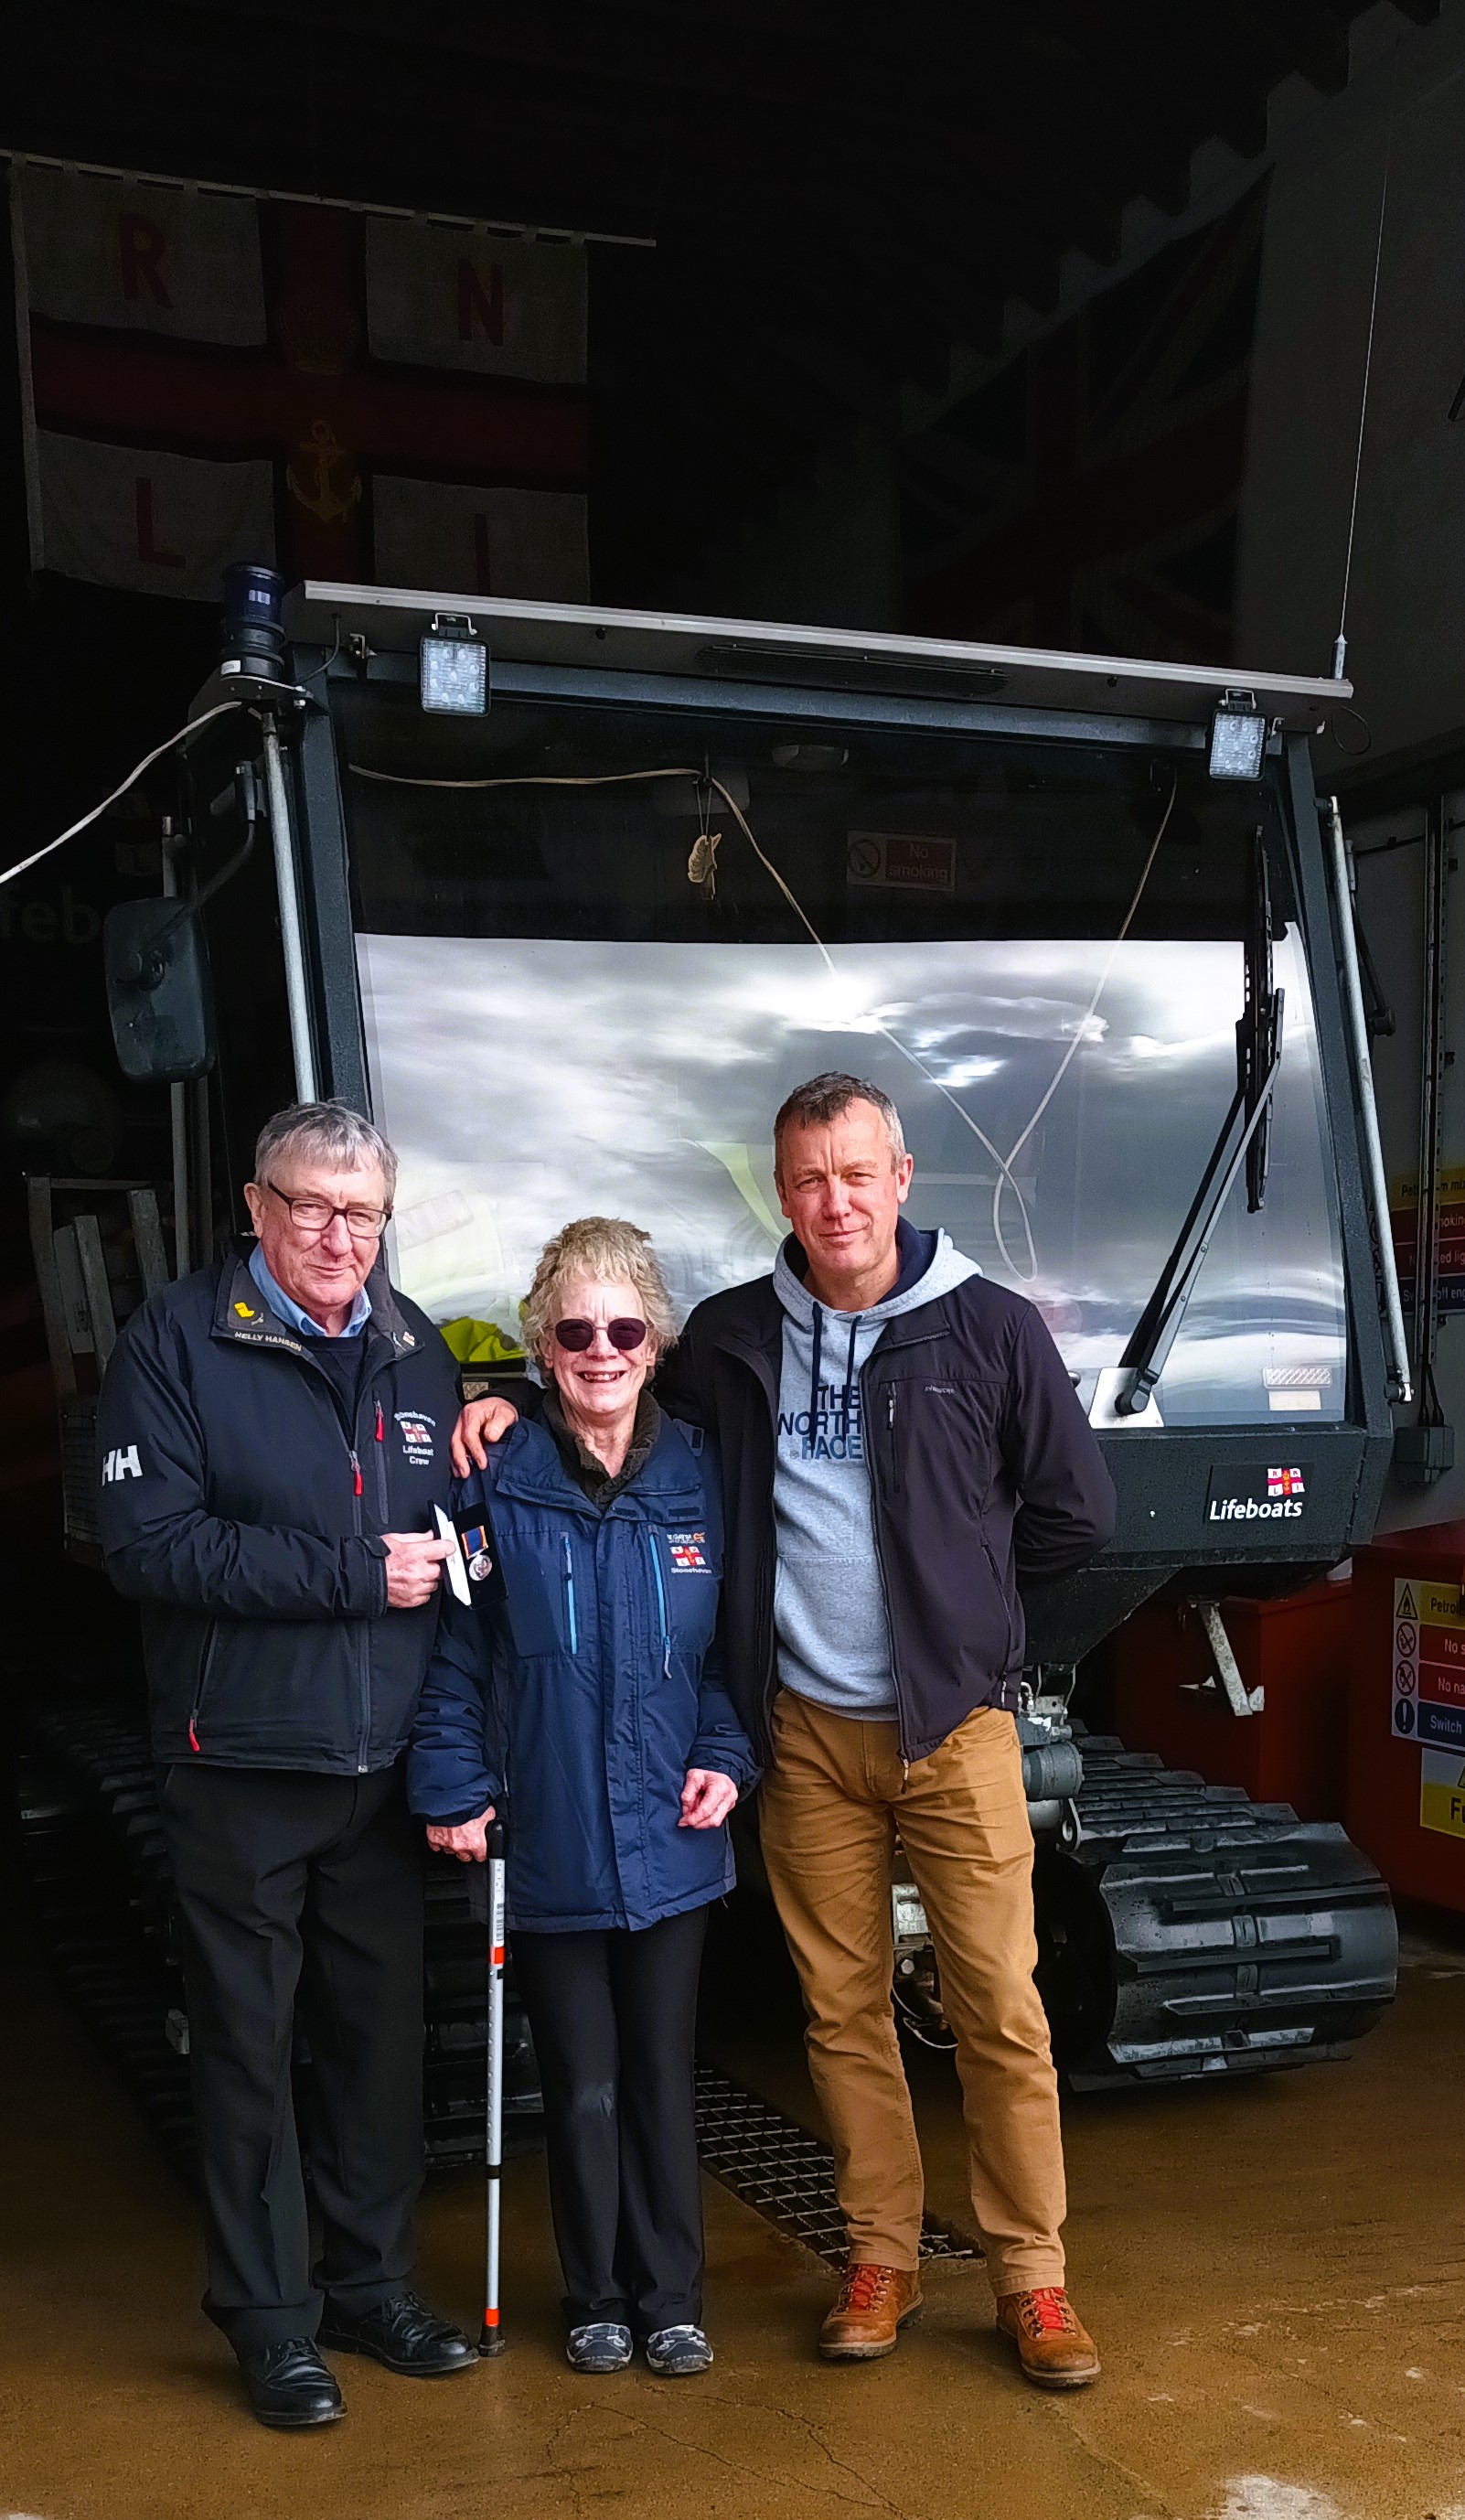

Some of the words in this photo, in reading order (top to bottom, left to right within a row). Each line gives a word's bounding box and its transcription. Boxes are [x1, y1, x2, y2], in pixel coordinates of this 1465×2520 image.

[117, 211, 173, 309] R
[457, 257, 505, 347] N
[134, 477, 187, 570] L
[474, 513, 492, 597] I
[908, 842, 929, 859] No
[233, 1331, 264, 1342] HELLY
[264, 1335, 303, 1352] HANSEN
[817, 1384, 861, 1410] THE
[778, 1410, 862, 1436] NORTH
[802, 1435, 863, 1460] FACE
[102, 1443, 144, 1487] HH
[409, 1455, 430, 1465] Crew
[1209, 1497, 1304, 1520] Lifeboats
[1444, 1638, 1459, 1654] No
[1438, 1676, 1451, 1692] No
[1429, 1714, 1462, 1734] Switch
